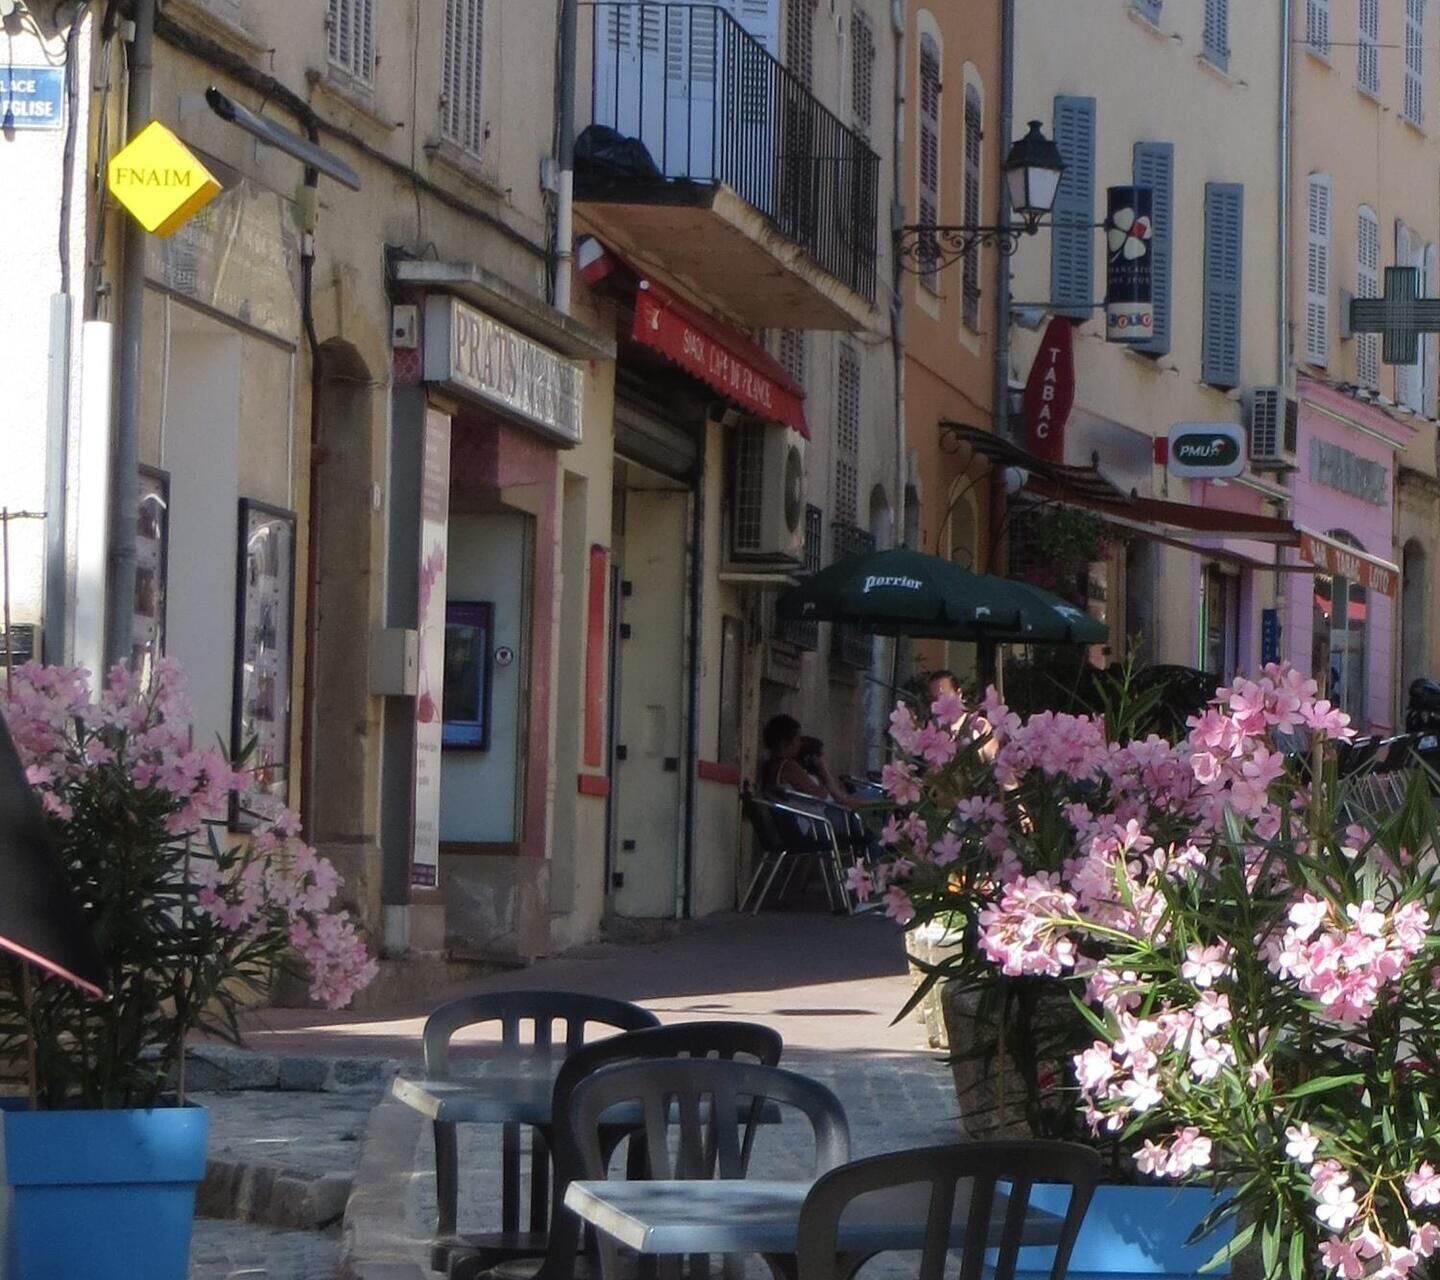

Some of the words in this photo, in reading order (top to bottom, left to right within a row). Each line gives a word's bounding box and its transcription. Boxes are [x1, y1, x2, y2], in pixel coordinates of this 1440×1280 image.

[116, 167, 192, 187] FNAIM
[1037, 347, 1060, 439] TABAC
[1180, 445, 1211, 457] PMU
[1368, 565, 1390, 594] LOTO
